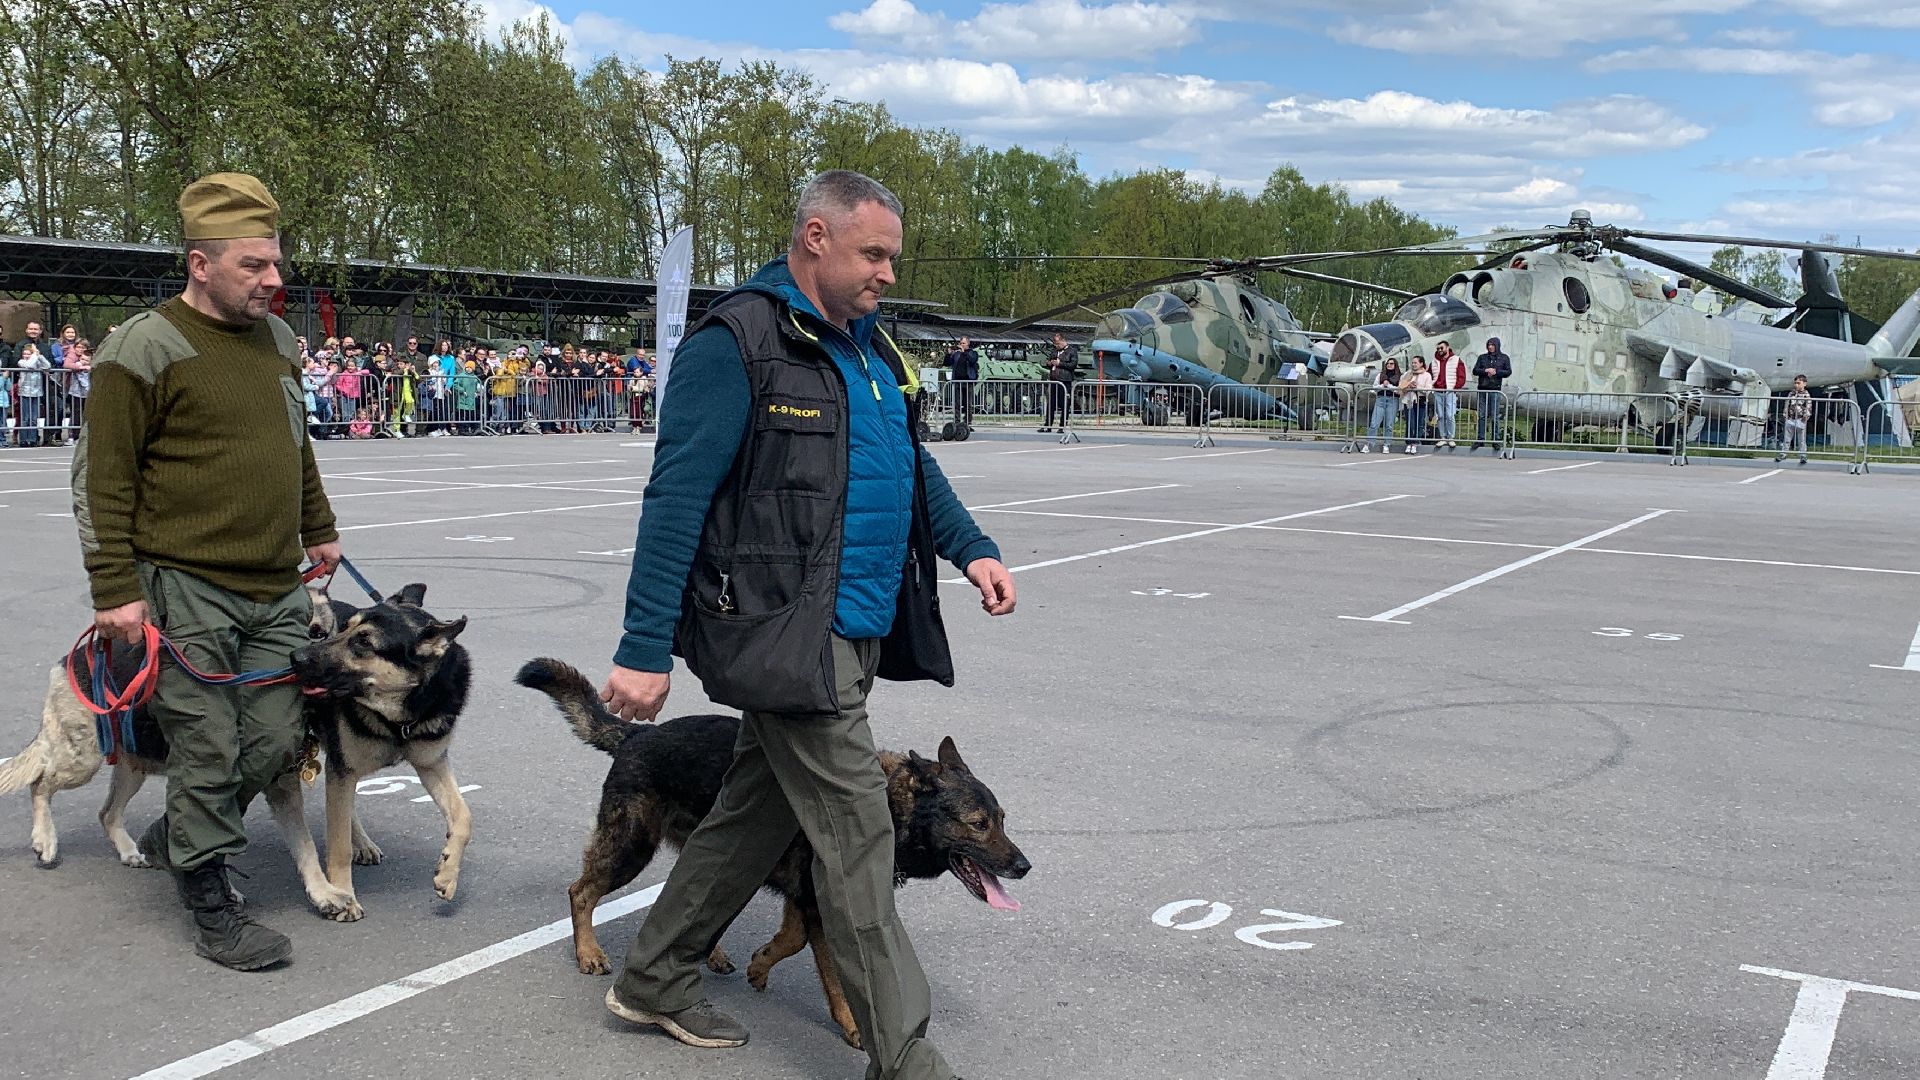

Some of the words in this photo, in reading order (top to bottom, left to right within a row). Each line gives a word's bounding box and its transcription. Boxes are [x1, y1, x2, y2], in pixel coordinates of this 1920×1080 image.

[668, 324, 683, 337] 100
[768, 404, 789, 414] K-9
[789, 407, 821, 418] PROFI
[1591, 627, 1685, 640] 35
[1151, 899, 1345, 950] 20
